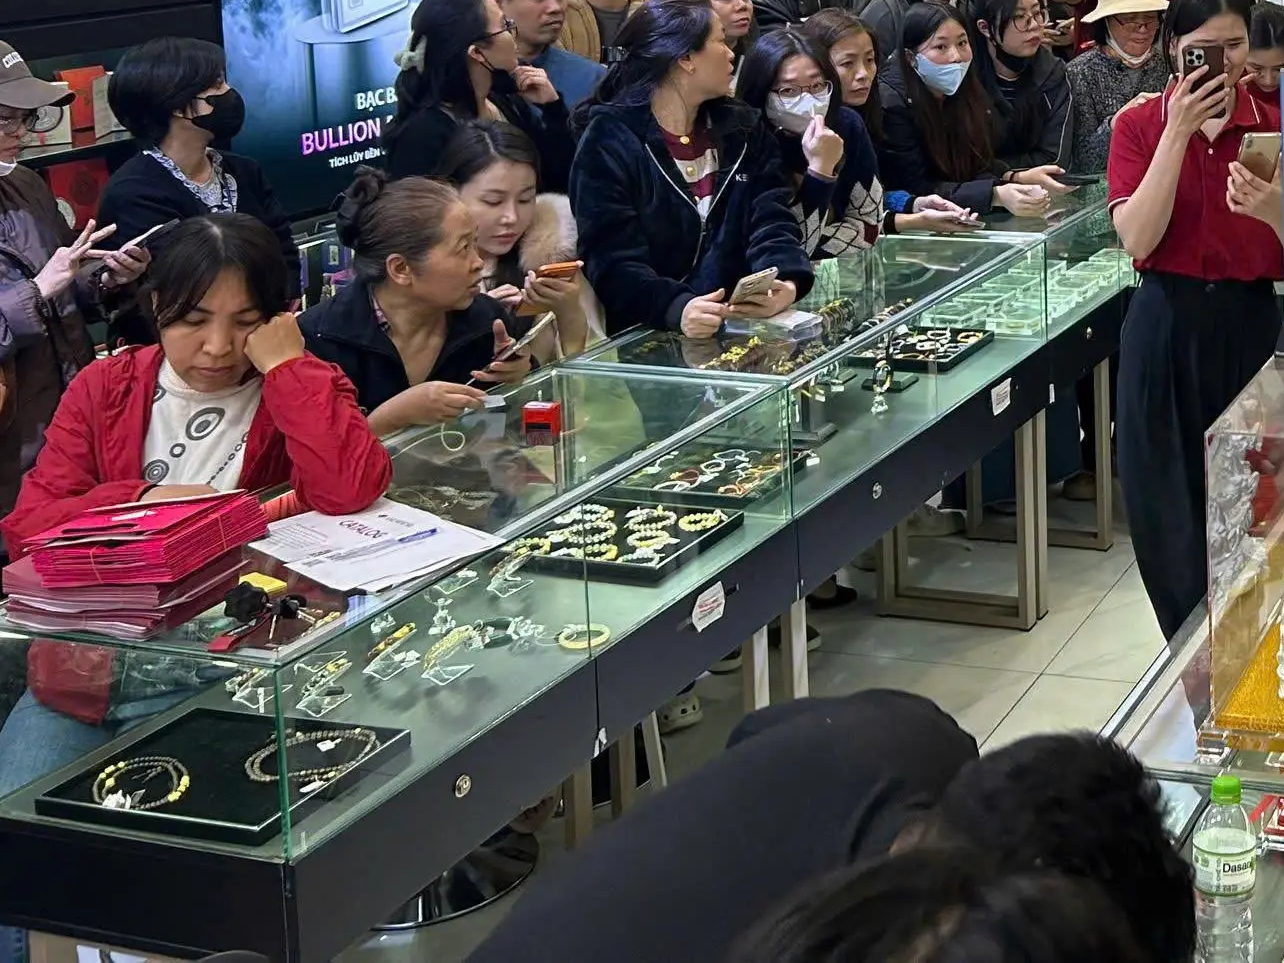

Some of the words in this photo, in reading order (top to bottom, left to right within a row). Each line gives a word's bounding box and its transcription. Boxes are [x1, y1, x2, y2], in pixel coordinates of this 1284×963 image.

[356, 88, 385, 112] BẠC
[301, 117, 381, 156] BULLION
[329, 156, 349, 169] TÍCH
[349, 151, 364, 164] LŨY
